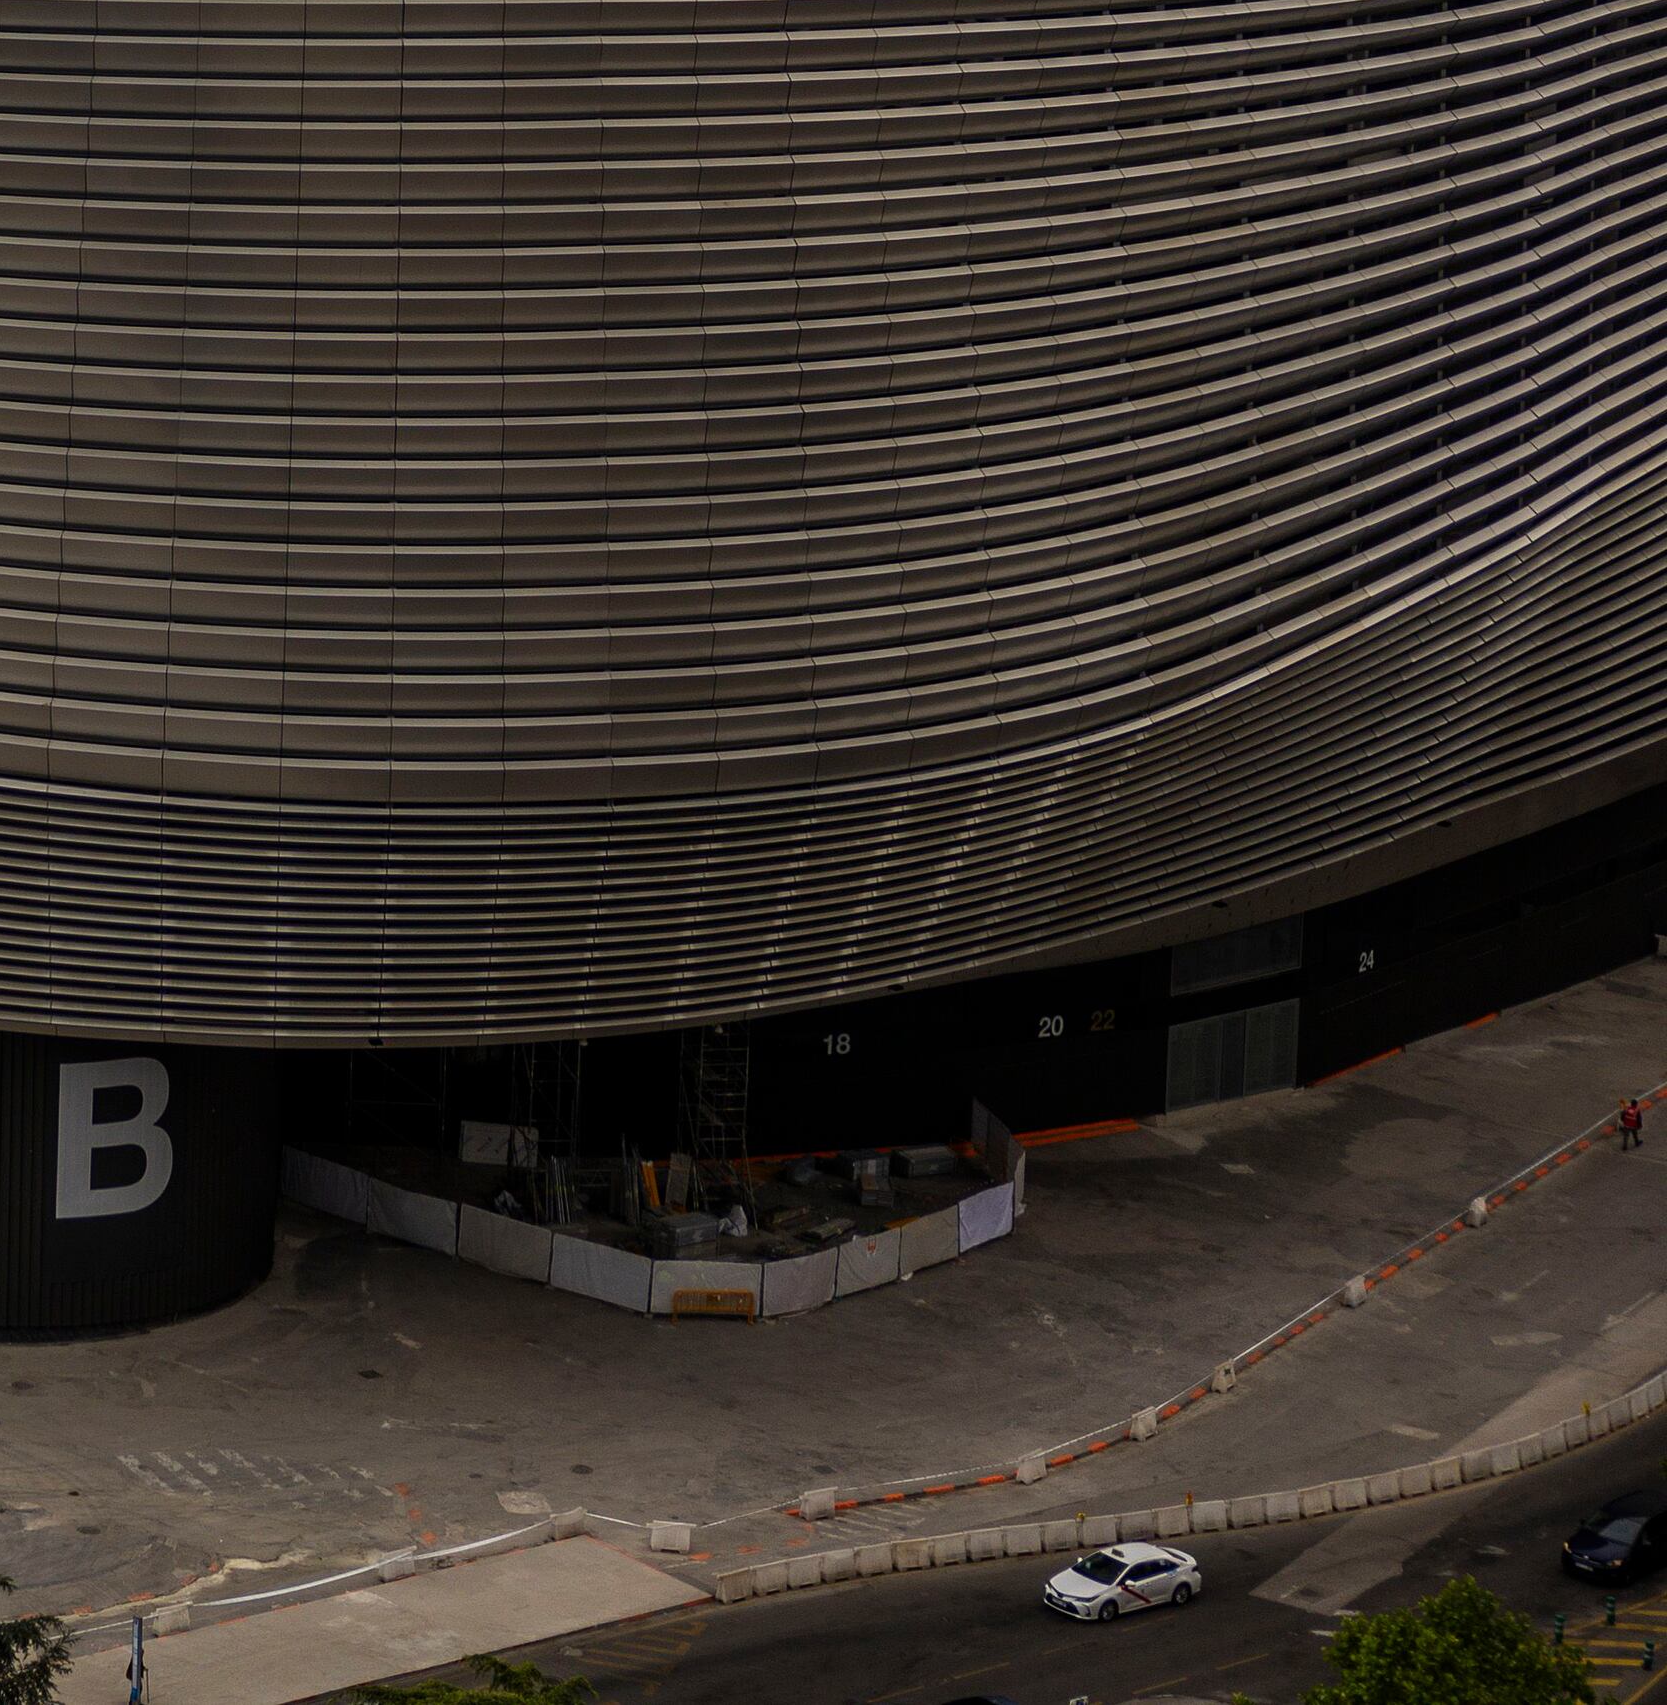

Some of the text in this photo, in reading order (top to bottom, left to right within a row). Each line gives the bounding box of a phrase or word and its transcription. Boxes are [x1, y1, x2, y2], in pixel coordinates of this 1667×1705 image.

[1358, 949, 1375, 973] 24
[1038, 1015, 1064, 1038] 20
[1090, 1009, 1115, 1031] 22
[823, 1033, 851, 1055] 18
[56, 1056, 173, 1219] B
